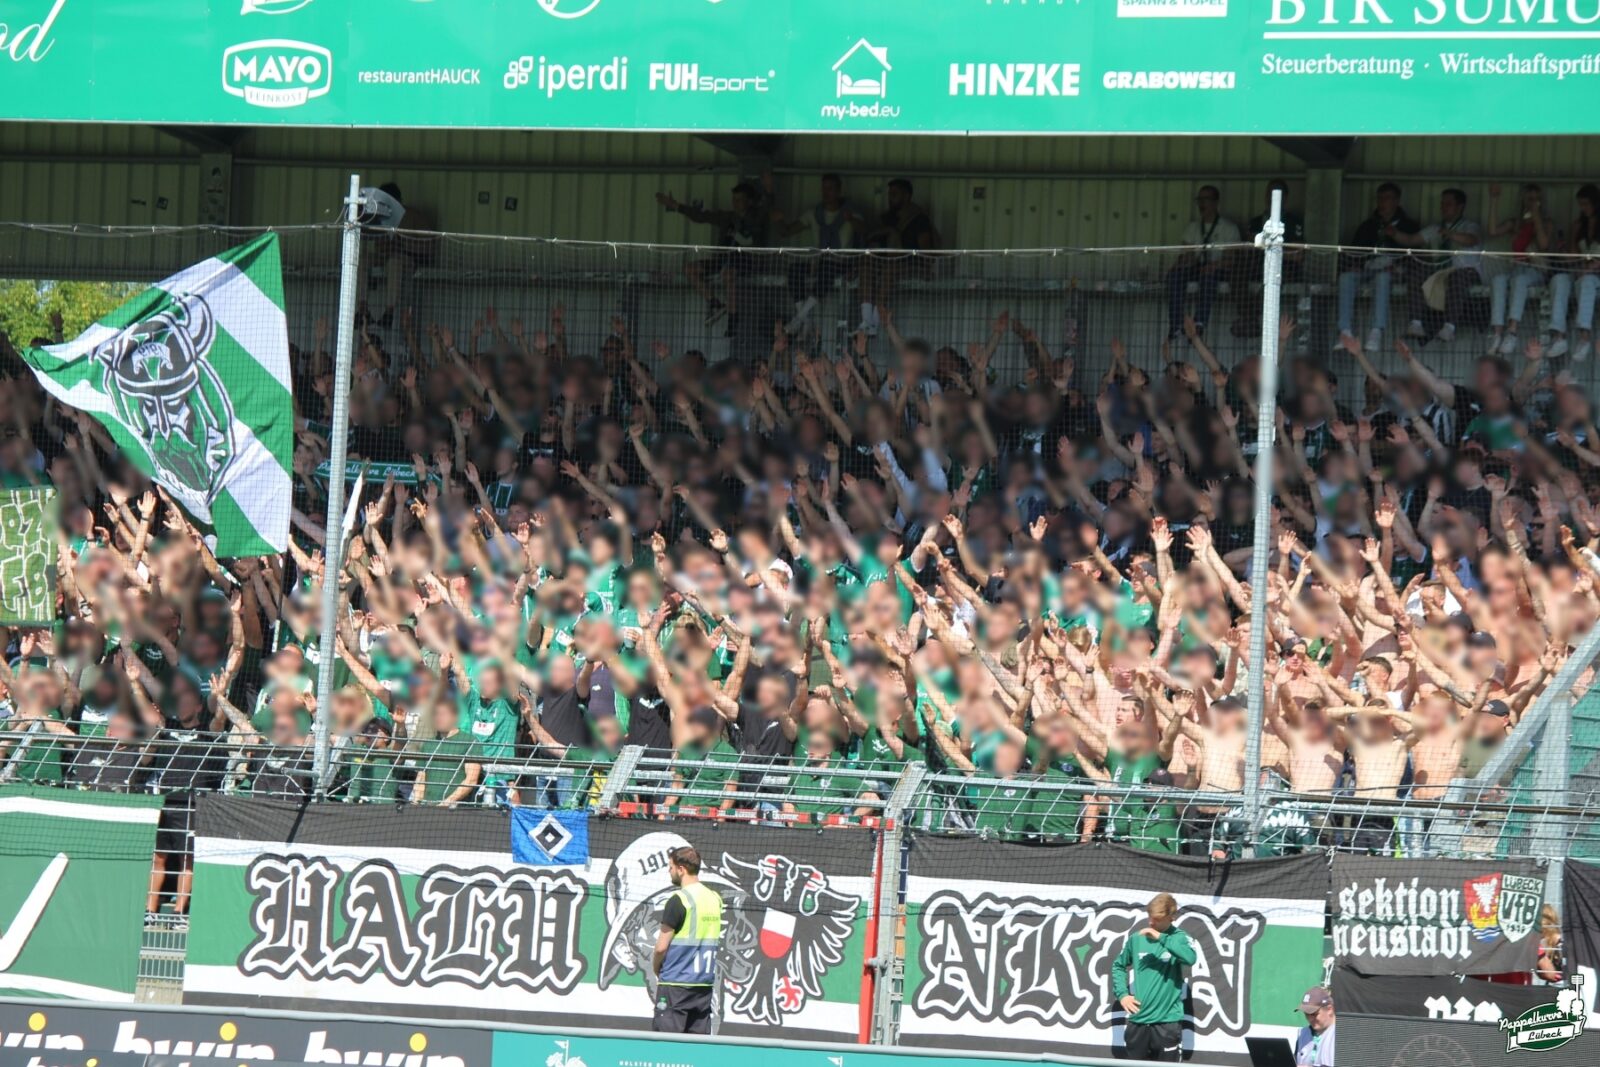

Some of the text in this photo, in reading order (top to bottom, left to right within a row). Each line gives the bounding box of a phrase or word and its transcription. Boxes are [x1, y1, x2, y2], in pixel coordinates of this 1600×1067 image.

[233, 55, 322, 84] MAYO
[358, 68, 481, 85] restaurantHAUCK
[538, 56, 629, 98] iperdi
[1261, 53, 1415, 79] Steuerberatung
[949, 63, 1081, 97] HINZKE
[1102, 71, 1236, 89] GRABOWSKI
[821, 101, 900, 120] my-bed.eu
